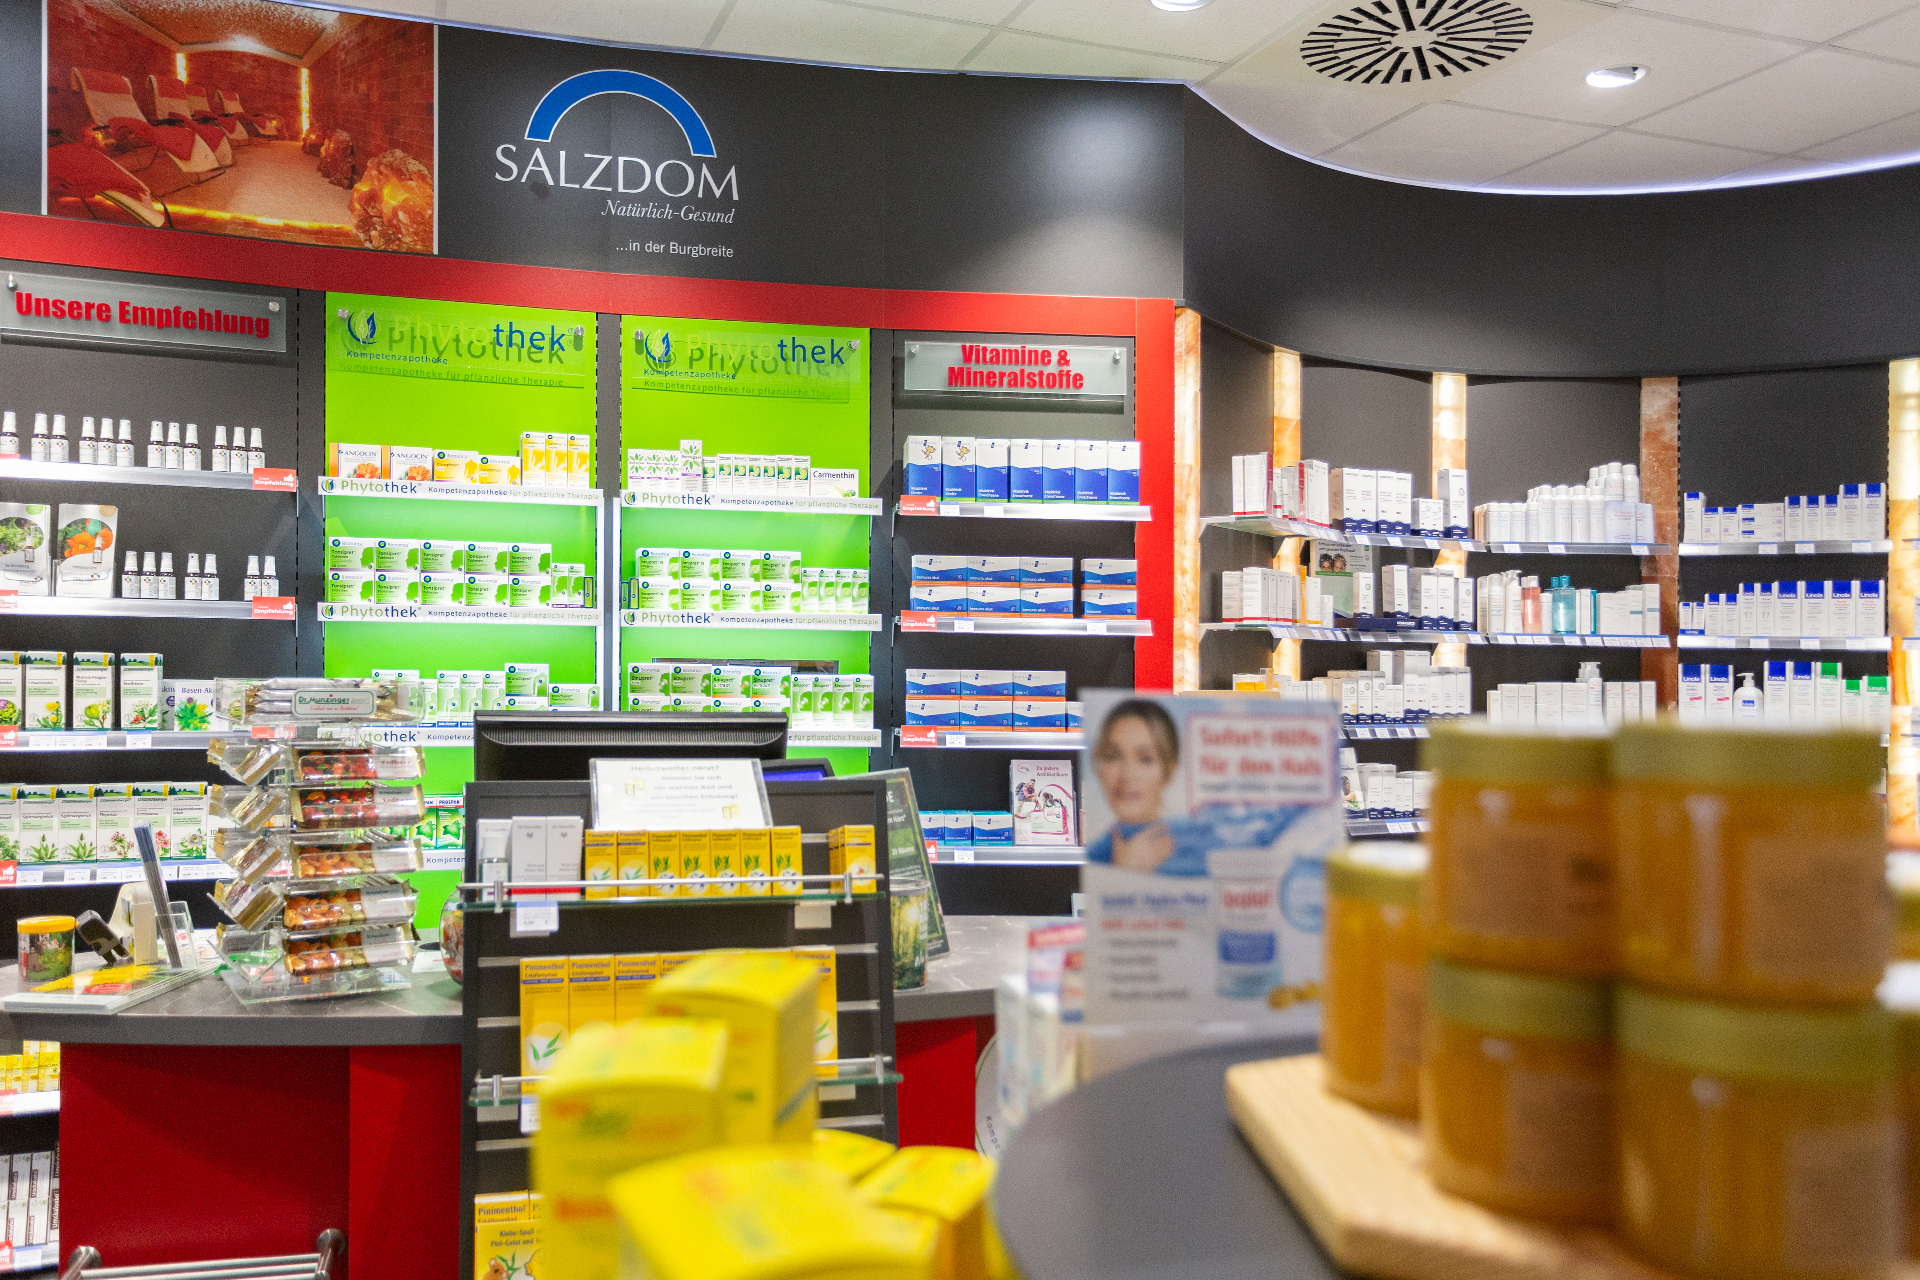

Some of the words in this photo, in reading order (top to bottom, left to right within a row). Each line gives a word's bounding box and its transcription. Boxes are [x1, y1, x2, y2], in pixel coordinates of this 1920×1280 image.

[495, 144, 739, 200] SALZDOM
[601, 200, 735, 224] Natürlich-Gesund
[645, 240, 665, 253] der
[669, 242, 734, 257] Burgbreite
[15, 291, 112, 322] Unsere
[118, 300, 270, 339] Empfehlung
[346, 350, 448, 365] Kompetenzapotheke
[961, 344, 1052, 366] Vitamine
[1056, 349, 1071, 366] &
[643, 368, 737, 380] Kompetenzapotheke
[947, 366, 1084, 389] Mineralstoffe
[812, 470, 855, 479] Carmenthin
[254, 479, 294, 487] Empfehlung
[341, 480, 418, 494] Phytothek
[428, 486, 508, 496] Kompetenzapotheke
[523, 490, 565, 498] pflanzliche
[567, 492, 600, 500] Therapie
[642, 492, 712, 506] Phytothek
[720, 498, 794, 506] Kompetenzapotheke
[254, 608, 294, 616] Empfehlung
[341, 605, 417, 620] Phytothek
[428, 610, 508, 618] Kompetenzapotheke
[641, 612, 711, 626] Phytothek
[720, 616, 794, 624] Kompetenzapotheke
[808, 617, 847, 625] pflanzliche
[359, 731, 417, 746] ytothek
[427, 733, 476, 742] Kompetenza
[807, 734, 846, 742] pflanzliche
[478, 1204, 526, 1215] Pinimenthol
